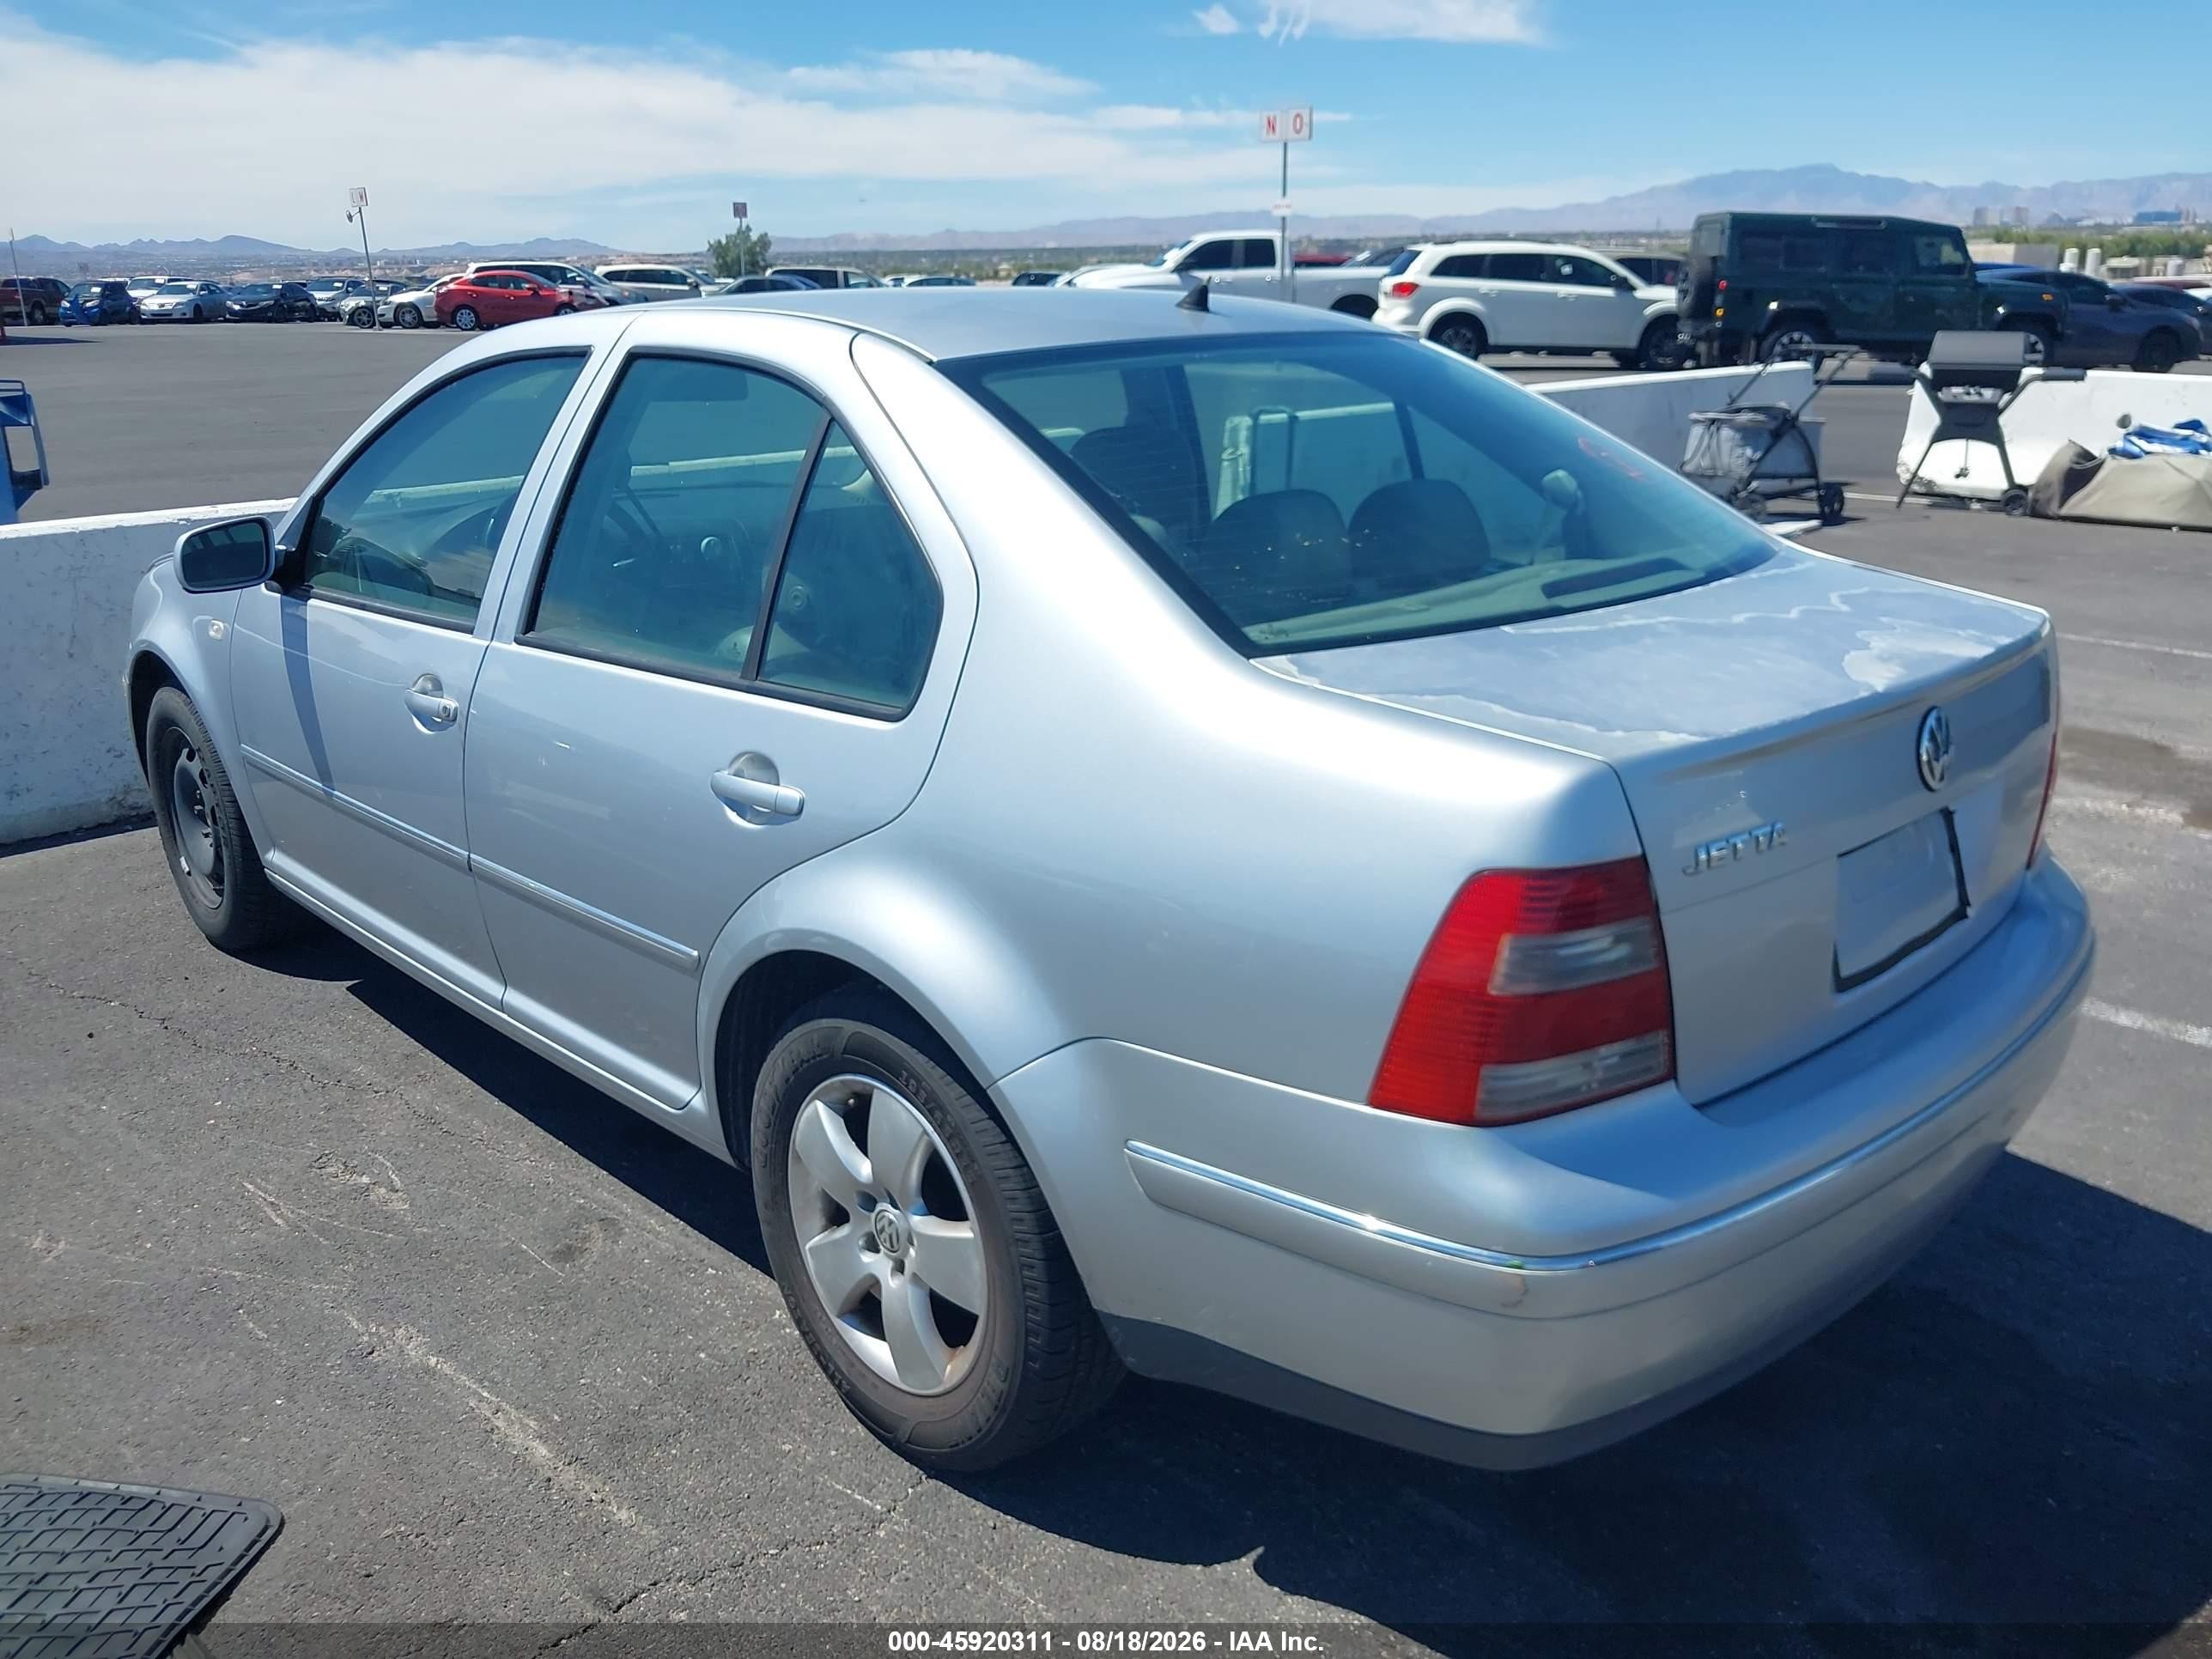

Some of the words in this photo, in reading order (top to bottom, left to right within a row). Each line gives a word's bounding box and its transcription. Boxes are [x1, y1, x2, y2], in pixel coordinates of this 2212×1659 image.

[1266, 116, 1277, 135] N
[1292, 112, 1304, 134] O
[1681, 821, 1786, 877] JETTA
